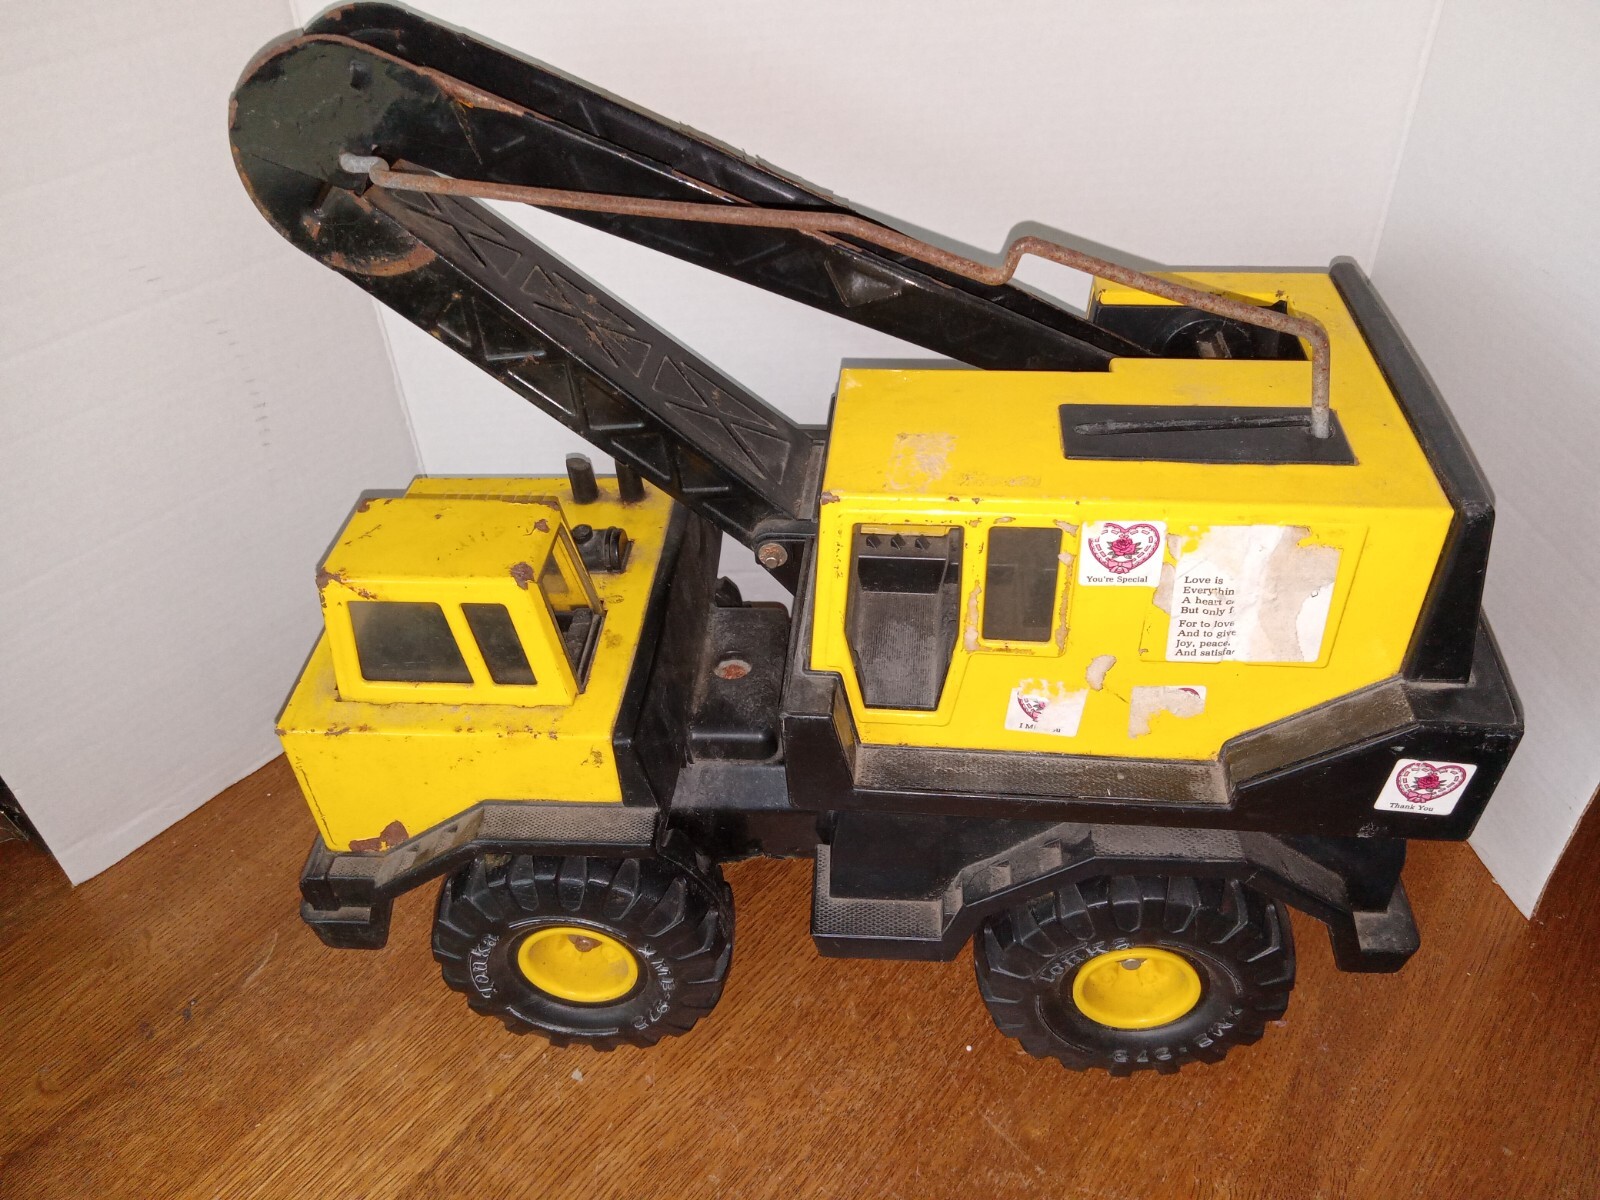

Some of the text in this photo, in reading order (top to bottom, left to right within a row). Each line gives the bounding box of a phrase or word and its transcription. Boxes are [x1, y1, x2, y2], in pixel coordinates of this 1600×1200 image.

[1086, 575, 1148, 584] You're Special
[1184, 576, 1224, 585] Love is
[1181, 596, 1191, 604] A
[1195, 596, 1222, 606] heart
[1181, 606, 1199, 614] But
[1202, 607, 1226, 617] only
[1178, 619, 1235, 628] For to love
[1177, 629, 1200, 637] And
[1216, 629, 1237, 639] give
[1175, 648, 1197, 657] And
[1389, 802, 1434, 812] Thank You
[469, 935, 500, 999] Tonka
